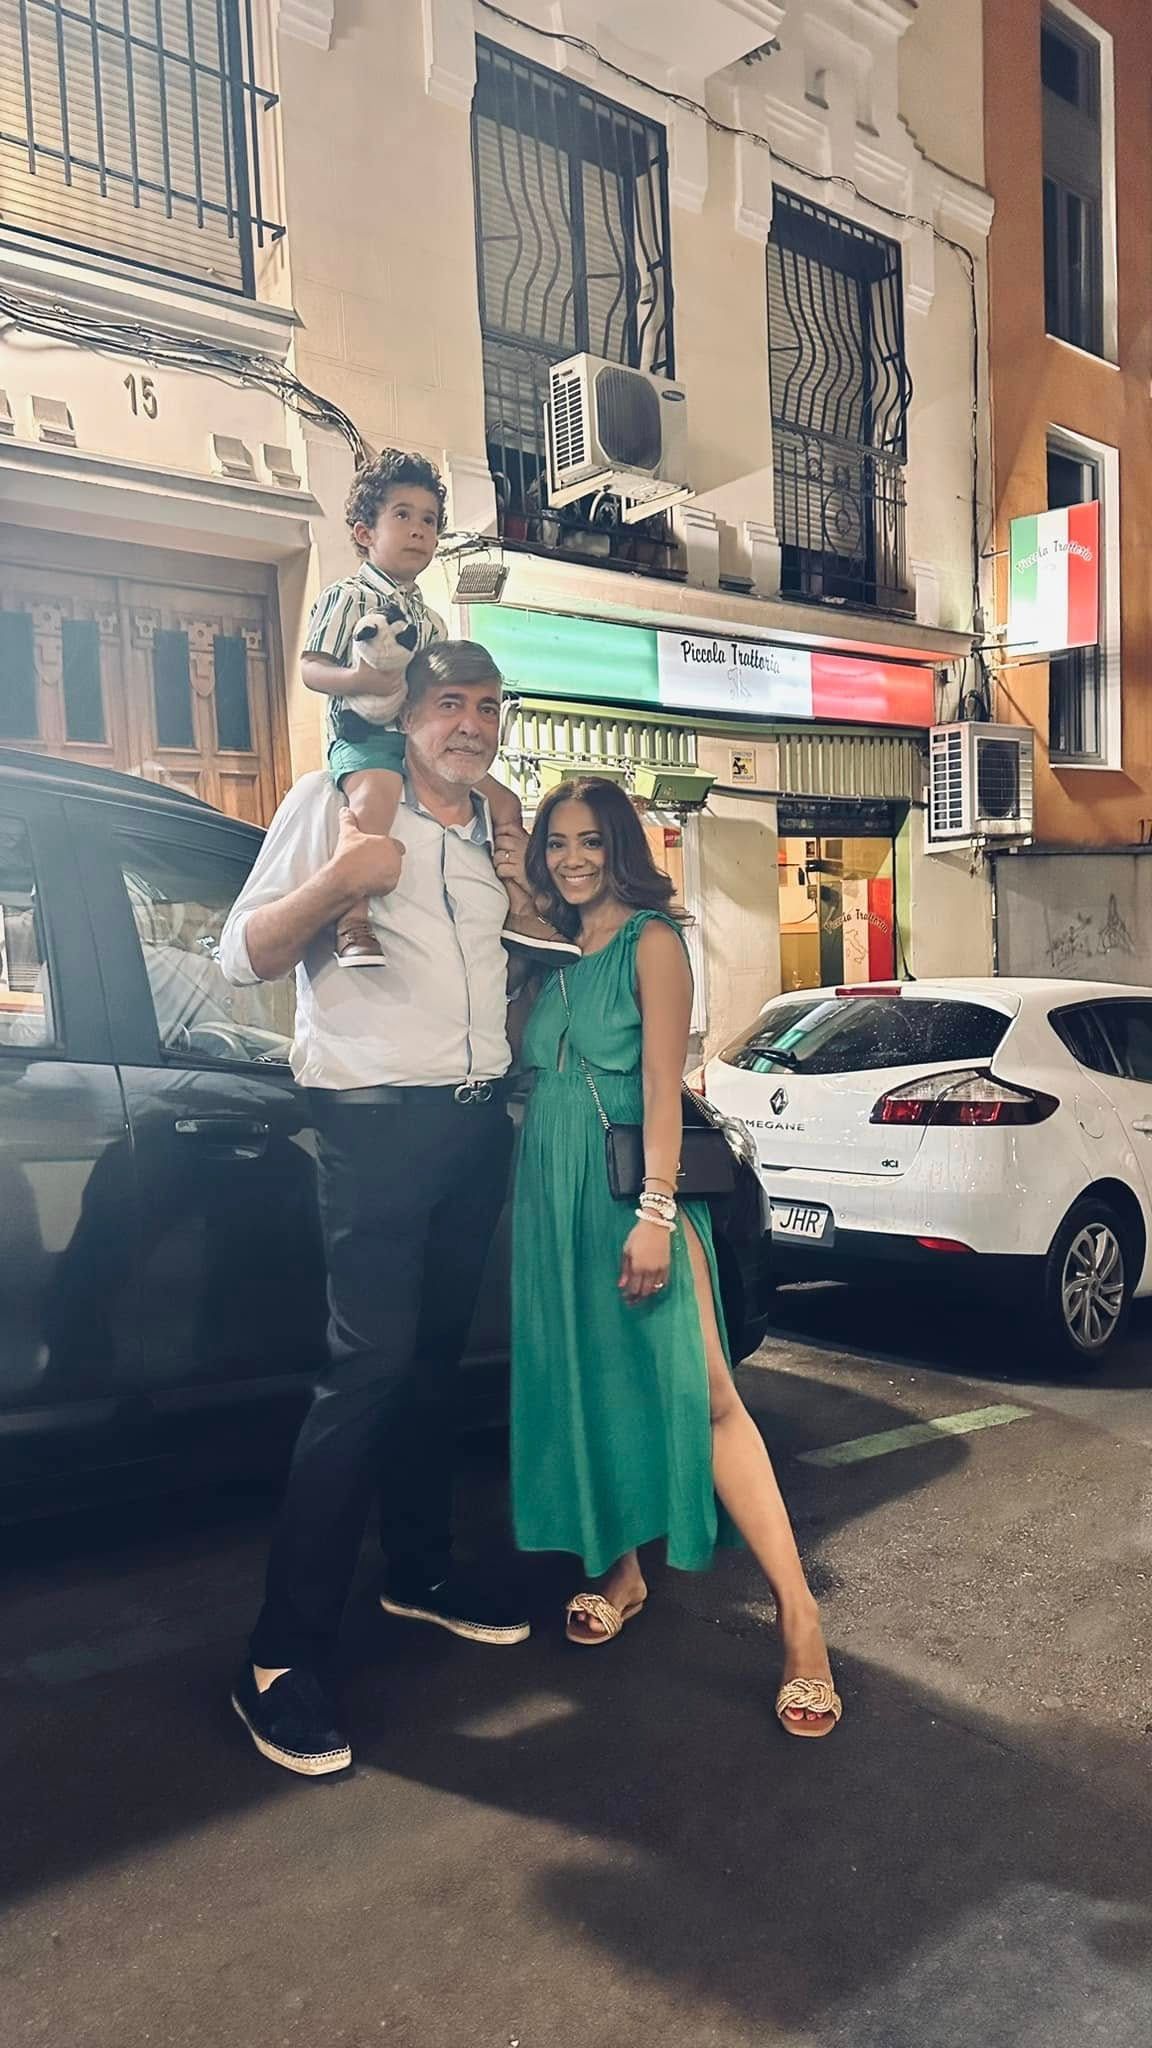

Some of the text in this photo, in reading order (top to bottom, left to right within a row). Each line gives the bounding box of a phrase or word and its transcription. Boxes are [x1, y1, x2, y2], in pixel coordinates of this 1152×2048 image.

[123, 373, 158, 420] 15
[681, 640, 780, 674] Piccola Trattoria
[746, 1119, 805, 1132] MEGANE
[779, 1207, 820, 1233] JHR
